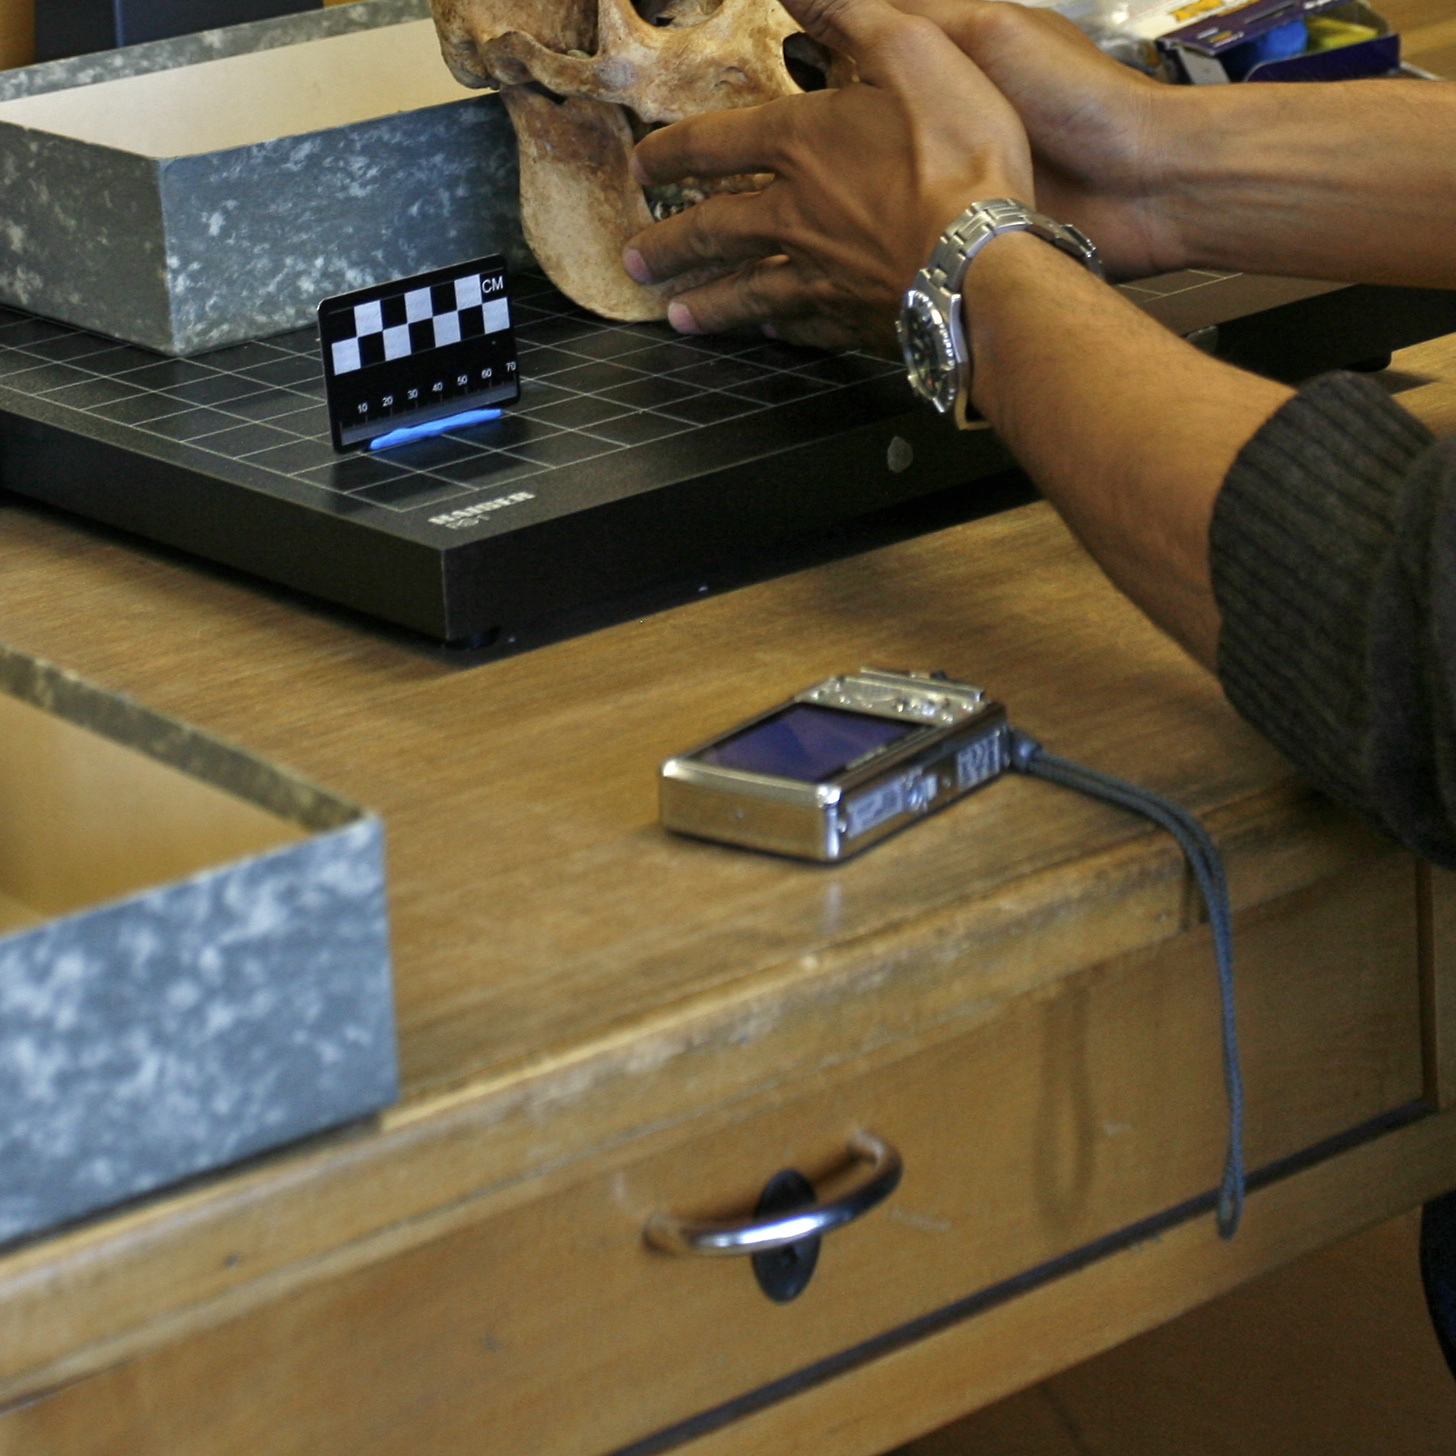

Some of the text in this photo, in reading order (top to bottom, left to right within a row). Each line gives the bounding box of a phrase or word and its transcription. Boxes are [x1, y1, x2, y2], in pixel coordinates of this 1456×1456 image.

[482, 276, 504, 293] CM
[357, 361, 516, 413] 10 20 30 40 50 60 70
